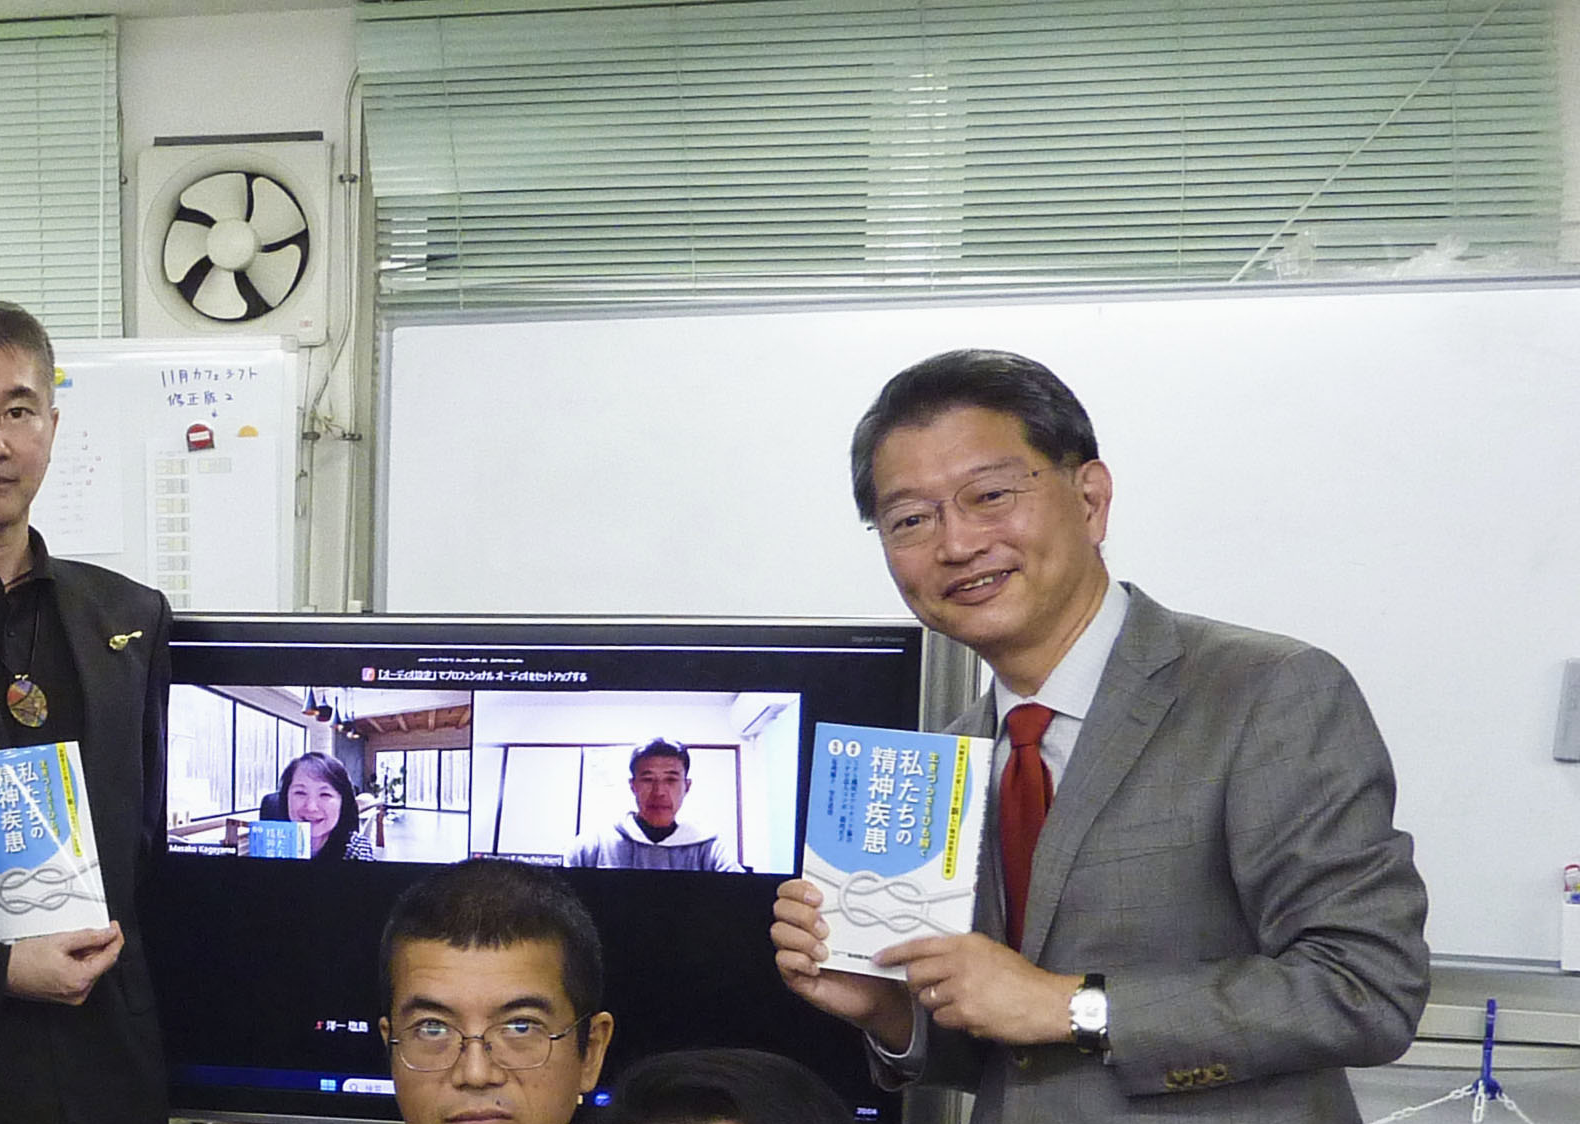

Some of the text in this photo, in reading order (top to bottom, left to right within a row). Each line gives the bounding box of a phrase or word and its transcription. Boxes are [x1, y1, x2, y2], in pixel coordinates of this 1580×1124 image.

[863, 747, 897, 855] 精神疾患
[896, 749, 924, 845] 私たちの
